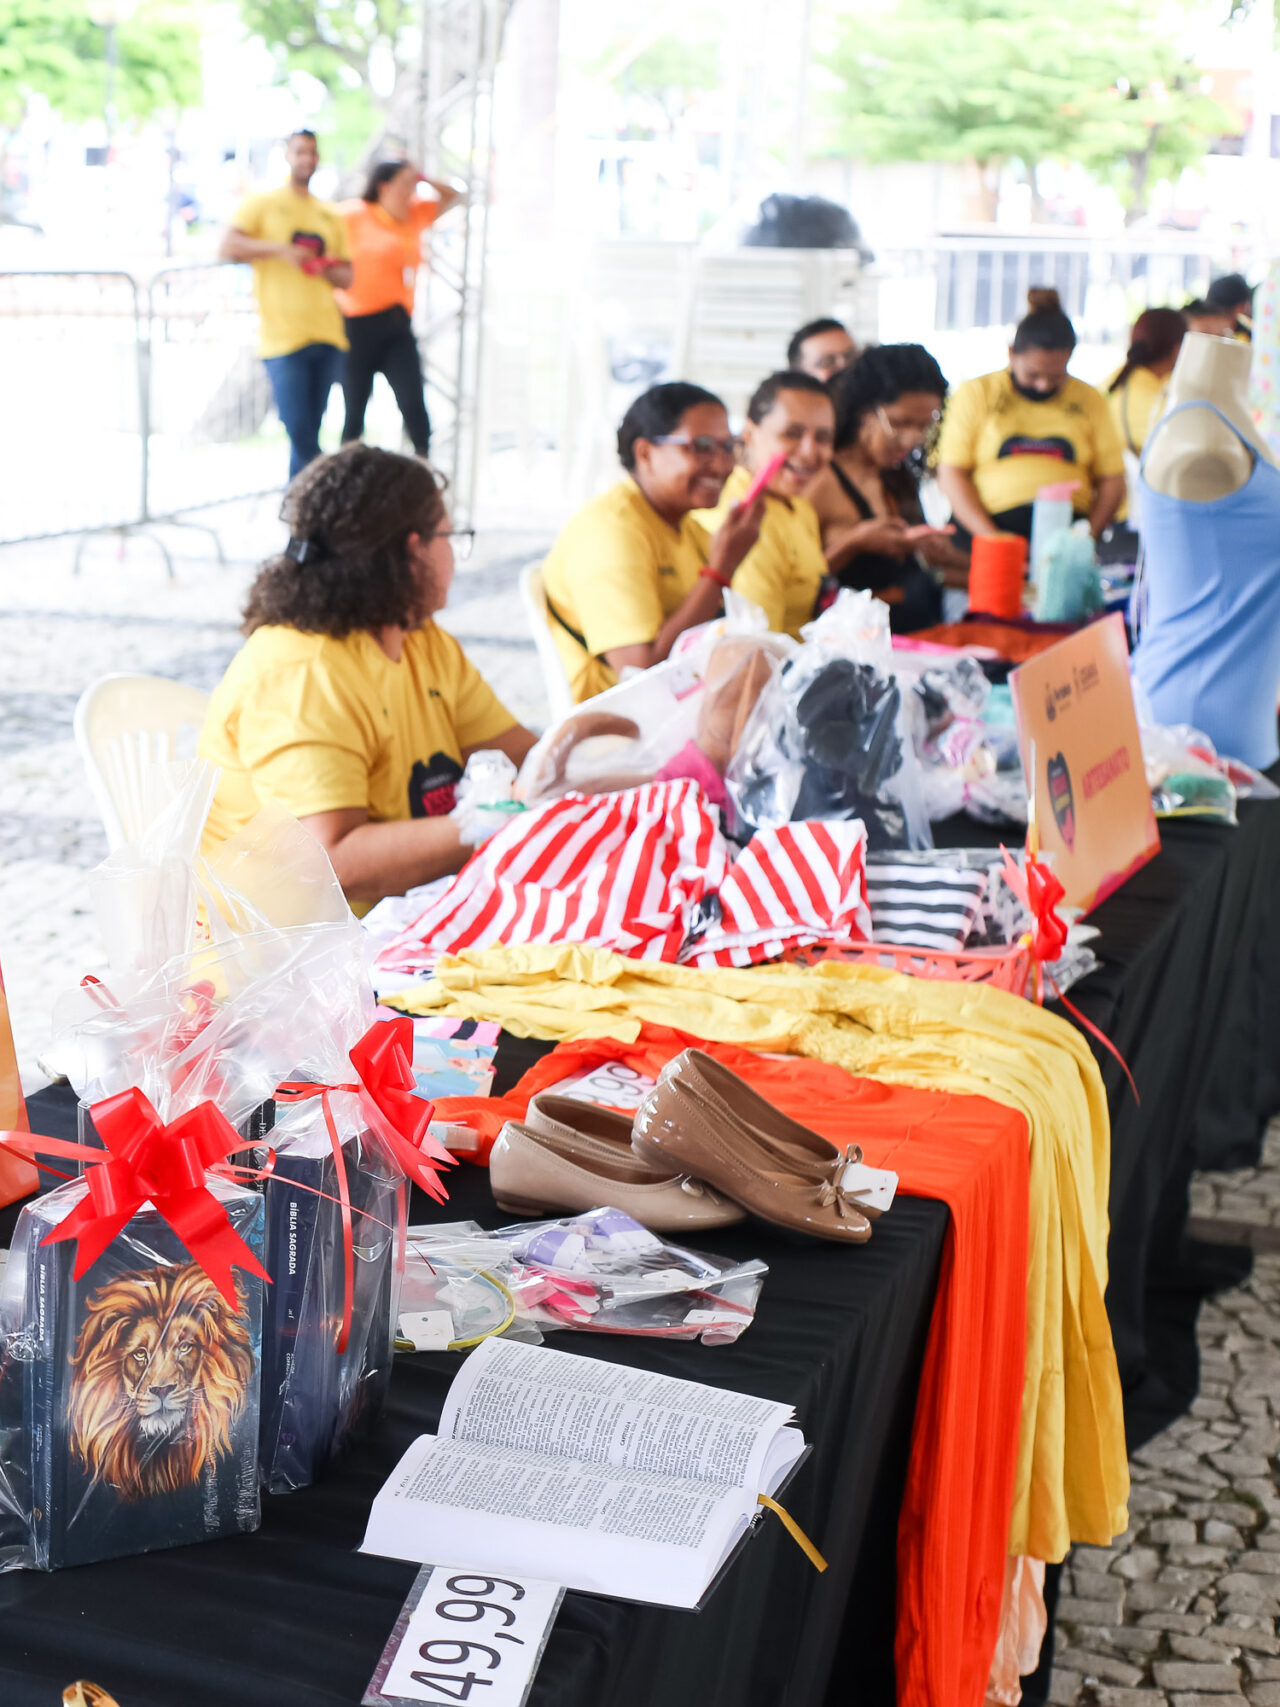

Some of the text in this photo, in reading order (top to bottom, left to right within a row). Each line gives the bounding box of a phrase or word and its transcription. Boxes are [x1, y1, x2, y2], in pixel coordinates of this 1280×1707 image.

[288, 1201, 299, 1275] BÍBLIA SAGRADA
[410, 1574, 526, 1701] 49,99
